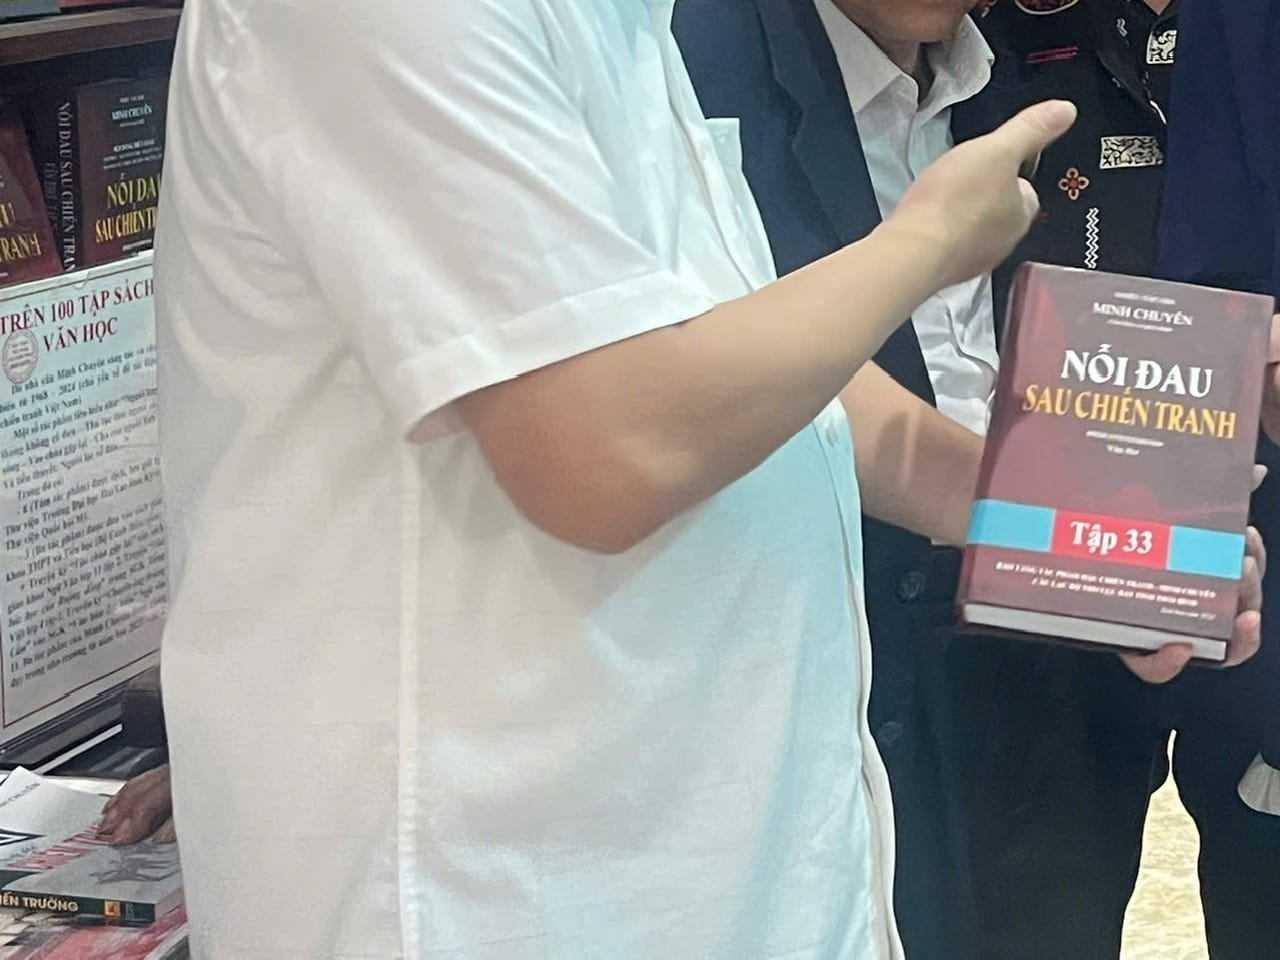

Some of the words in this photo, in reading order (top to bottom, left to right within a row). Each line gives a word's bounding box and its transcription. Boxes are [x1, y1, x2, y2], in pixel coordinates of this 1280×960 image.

[59, 129, 73, 160] ĐAU
[60, 161, 73, 191] SAU
[107, 172, 134, 209] NỖI
[95, 217, 116, 243] SAU
[0, 304, 45, 335] TRÊN
[51, 299, 75, 322] 100
[80, 289, 110, 318] TẬP
[113, 277, 154, 306] SÁCH
[1093, 302, 1130, 318] MINH
[1133, 309, 1193, 326] CHUYÊN
[44, 325, 82, 353] VĂN
[83, 316, 118, 344] HỌC
[57, 365, 75, 381] Minh
[1060, 343, 1128, 386] NỖI
[1134, 359, 1213, 398] ĐAU
[1022, 384, 1072, 416] SAU
[1074, 387, 1149, 428] CHIẾN
[1155, 401, 1236, 439] TRANH
[1070, 520, 1118, 555] Tập
[1123, 527, 1154, 554] 33
